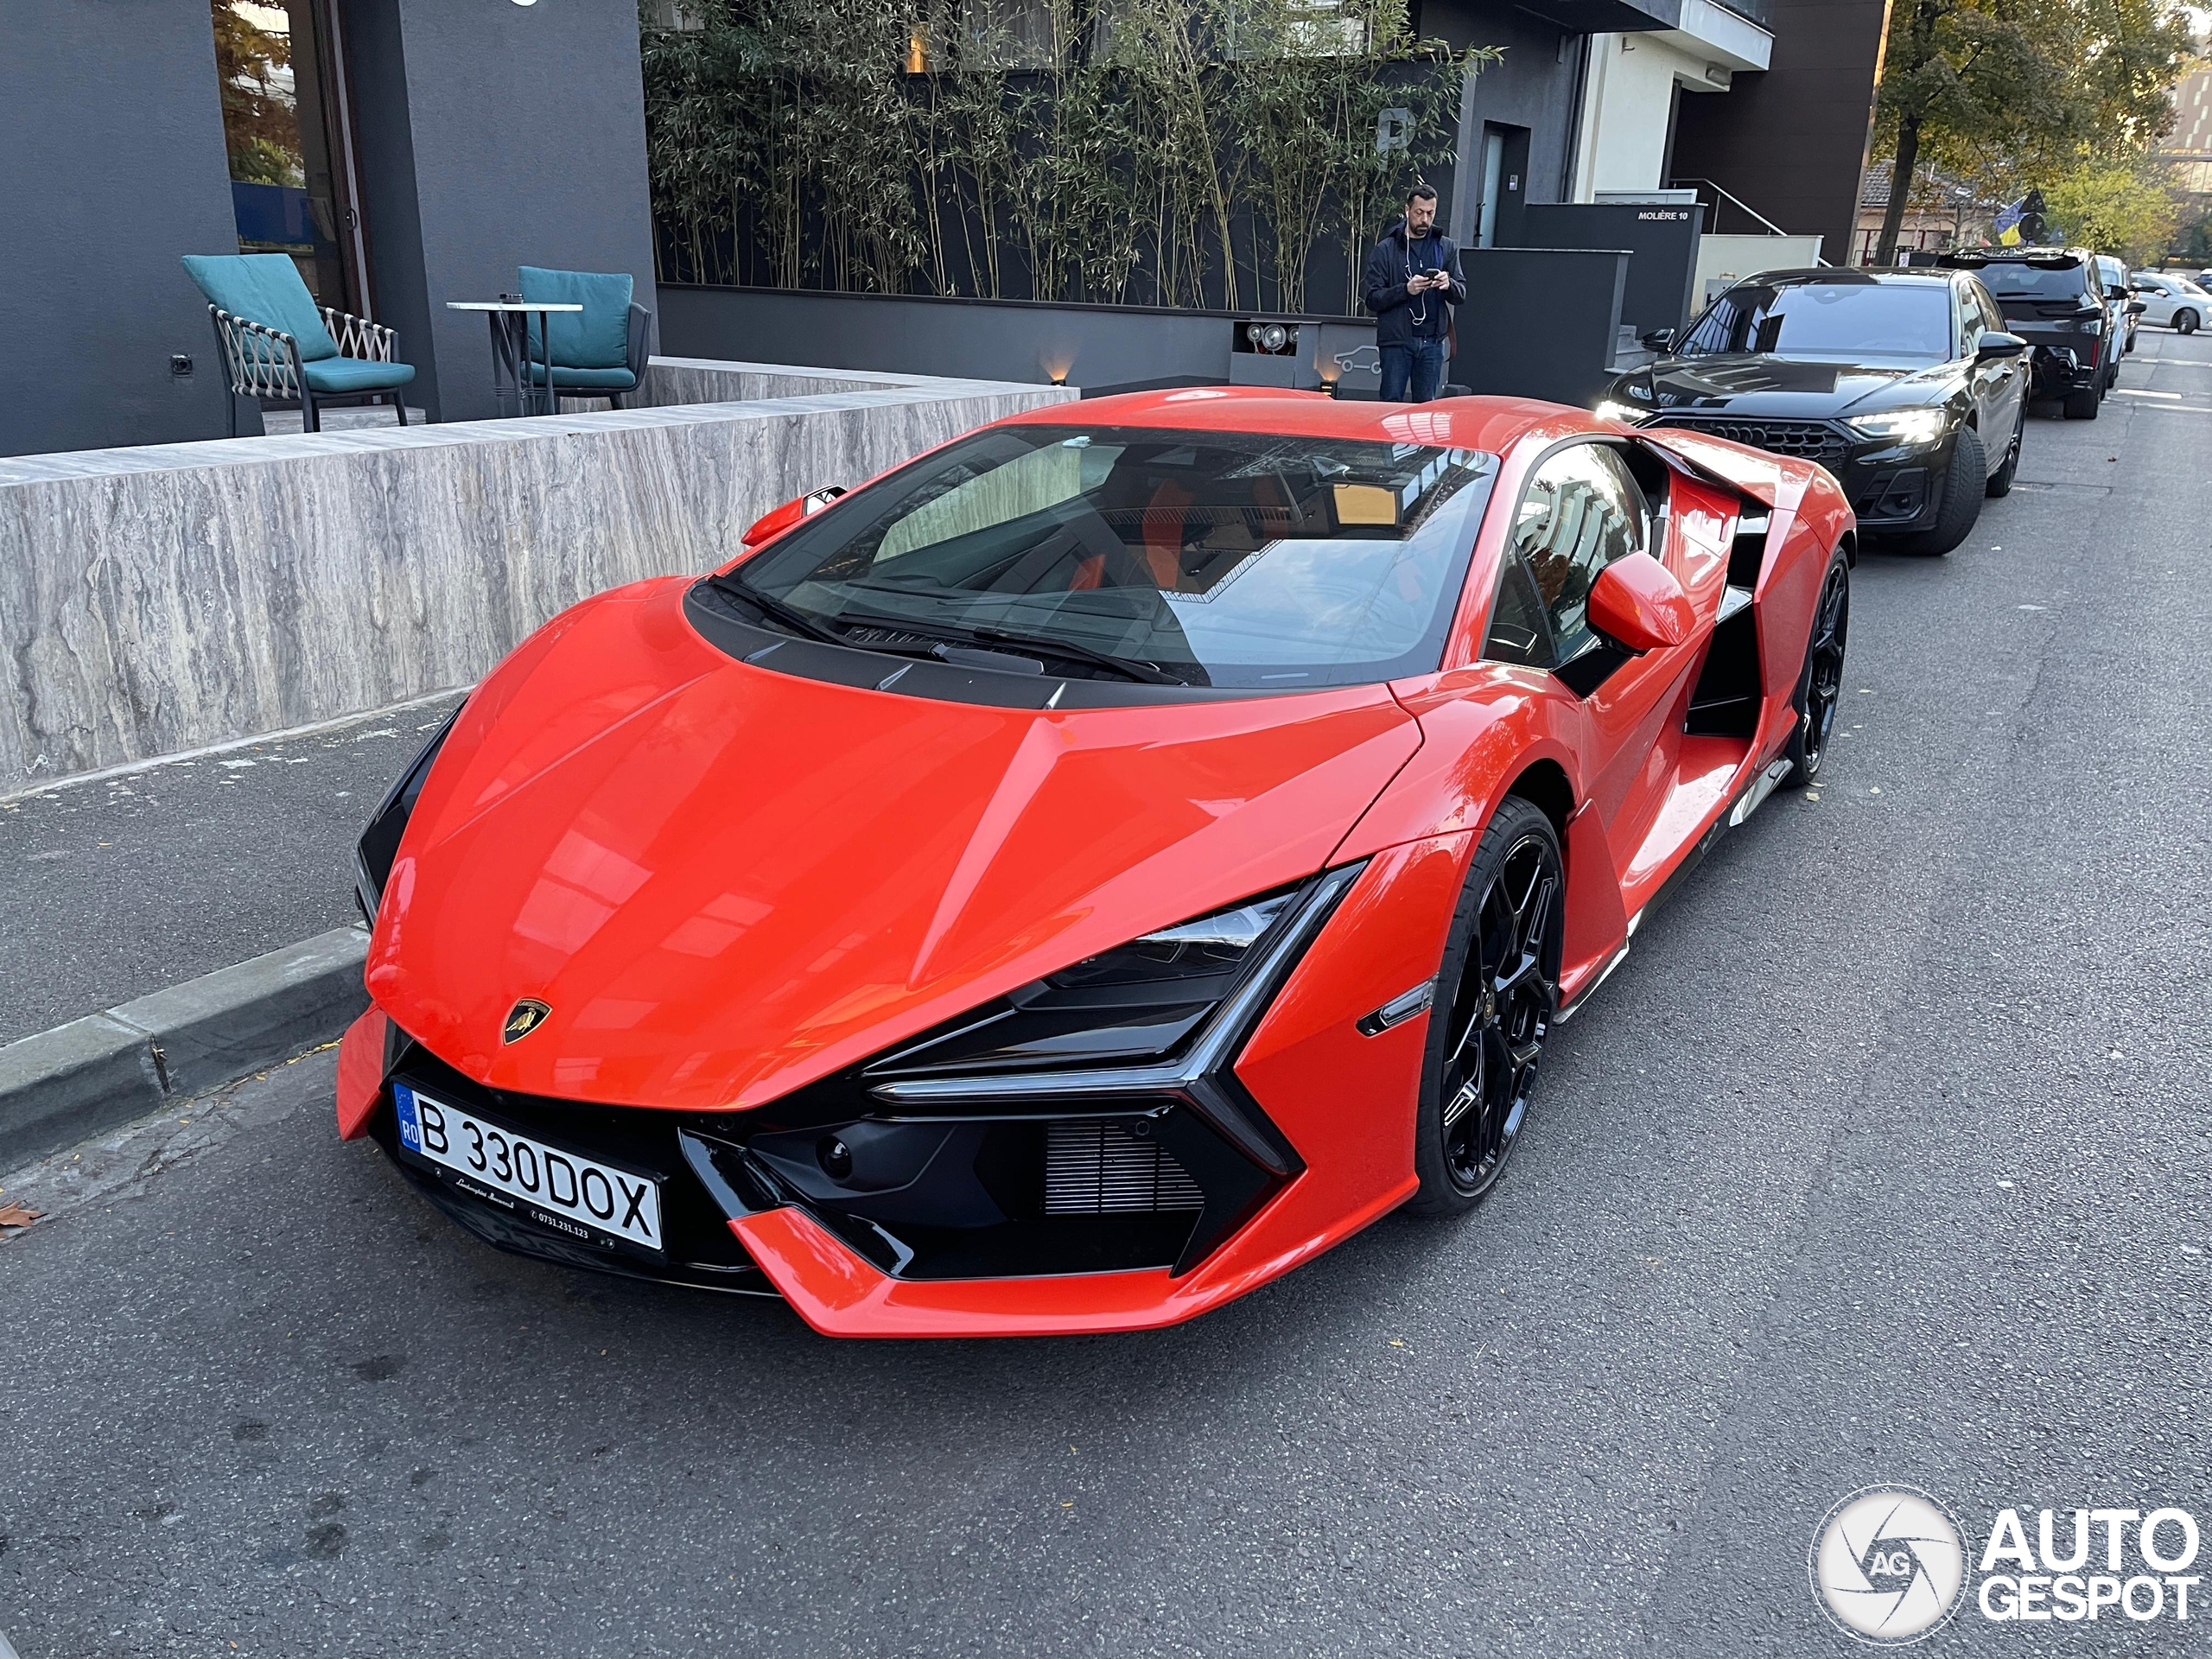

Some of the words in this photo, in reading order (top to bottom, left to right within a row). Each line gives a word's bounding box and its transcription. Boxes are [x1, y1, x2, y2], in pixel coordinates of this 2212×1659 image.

[1376, 107, 1416, 172] P
[1637, 209, 1677, 220] MOLIÈRE
[1678, 212, 1688, 220] 10
[402, 1119, 419, 1145] RO
[417, 1098, 449, 1155] B
[538, 1212, 588, 1239] 0731.231.123
